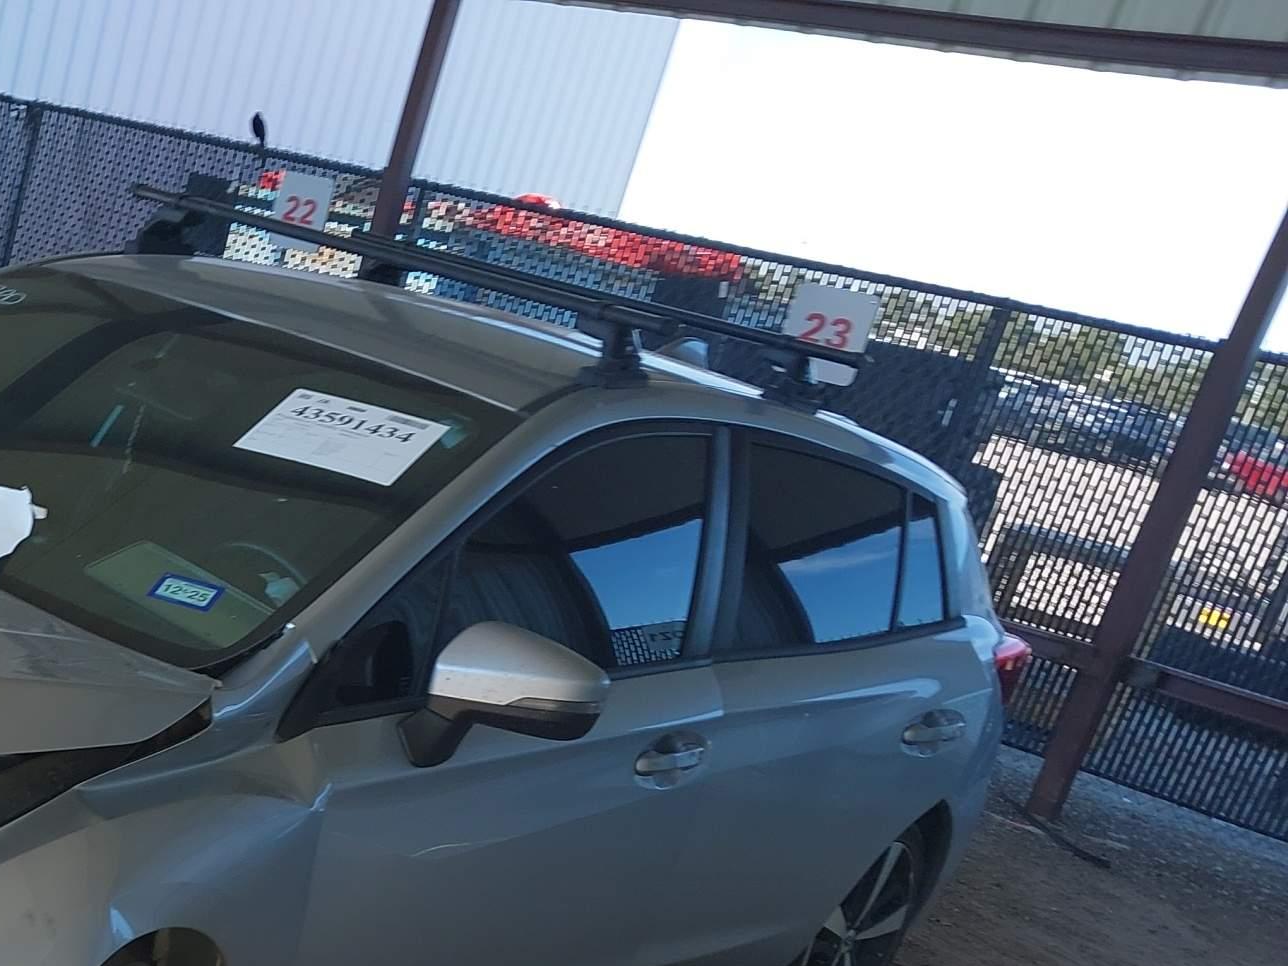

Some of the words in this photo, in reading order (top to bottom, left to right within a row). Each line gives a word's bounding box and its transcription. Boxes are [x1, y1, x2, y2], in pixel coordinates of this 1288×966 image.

[282, 195, 317, 225] 22
[799, 313, 851, 348] 23
[290, 404, 416, 443] 43591434
